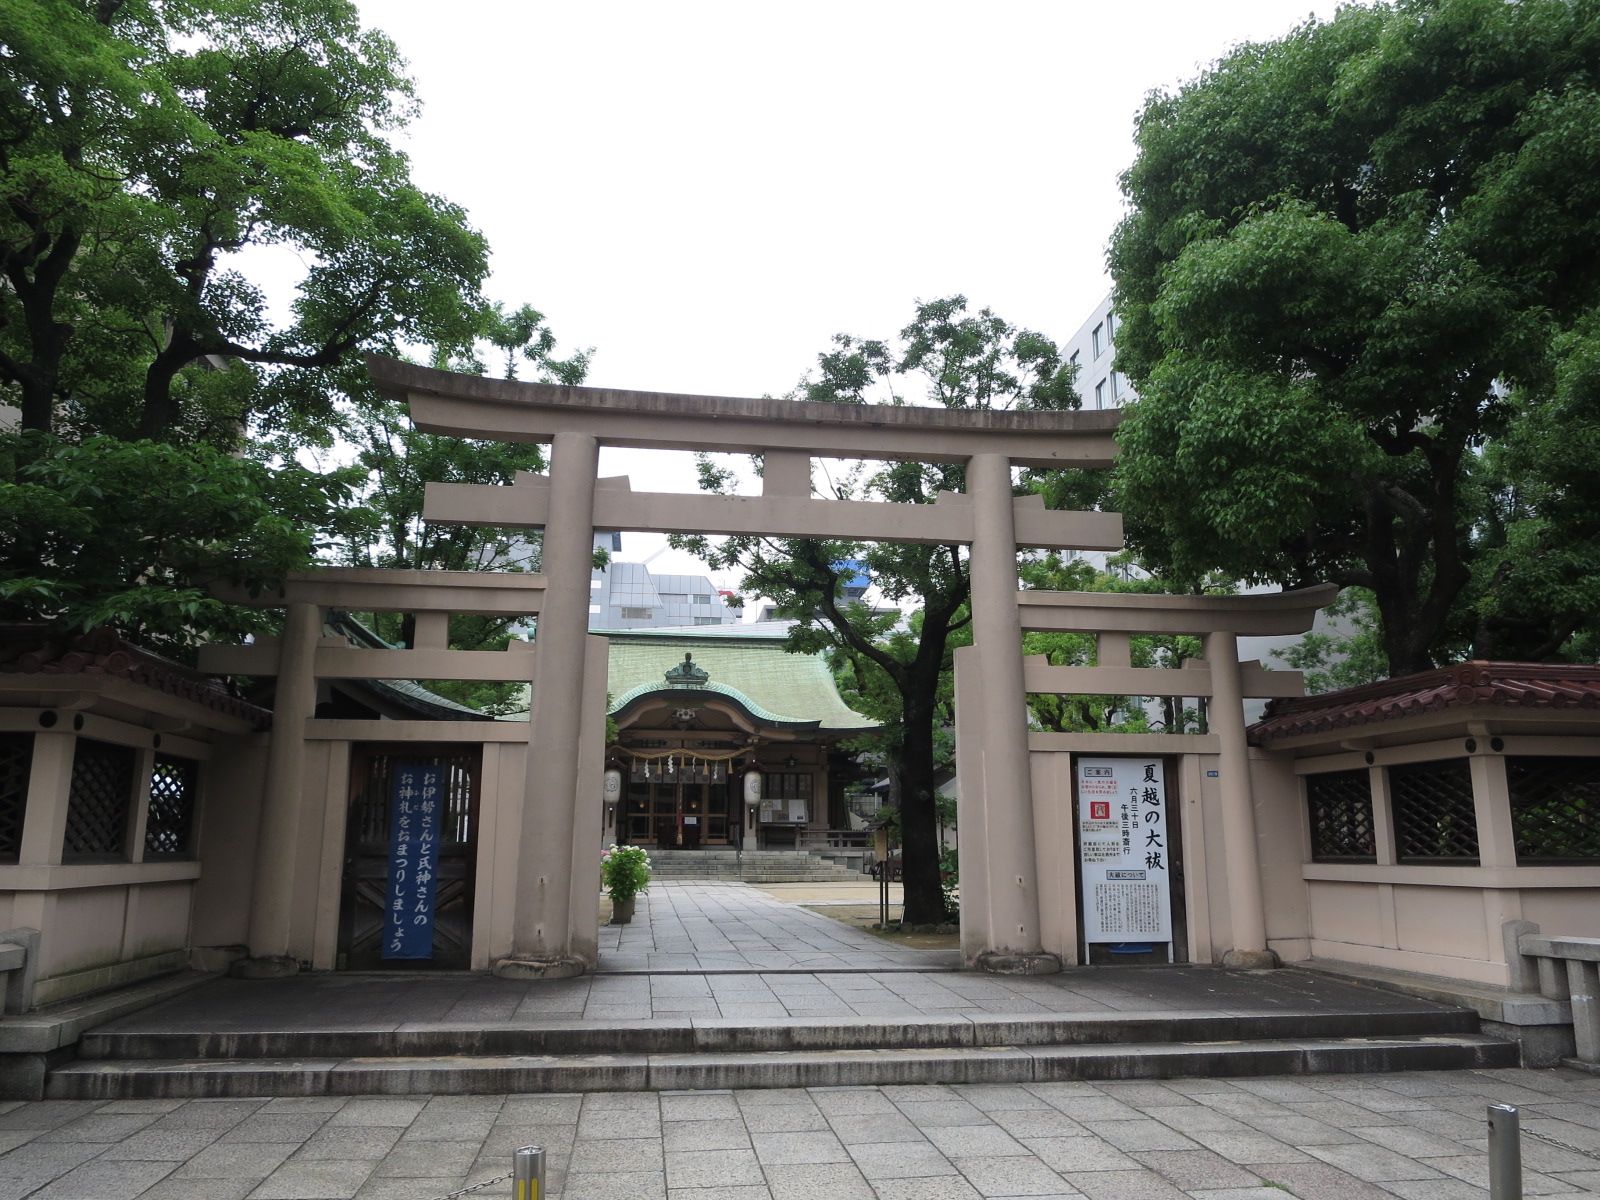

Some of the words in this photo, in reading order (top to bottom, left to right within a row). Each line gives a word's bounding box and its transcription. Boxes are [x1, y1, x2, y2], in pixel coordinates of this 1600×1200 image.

[390, 773, 414, 952] お神札をおまつりしましょう
[413, 773, 436, 925] お伊勢さんと氏神さんの
[1130, 787, 1139, 829] 六月三十日
[1142, 764, 1165, 870] 夏越の大祓
